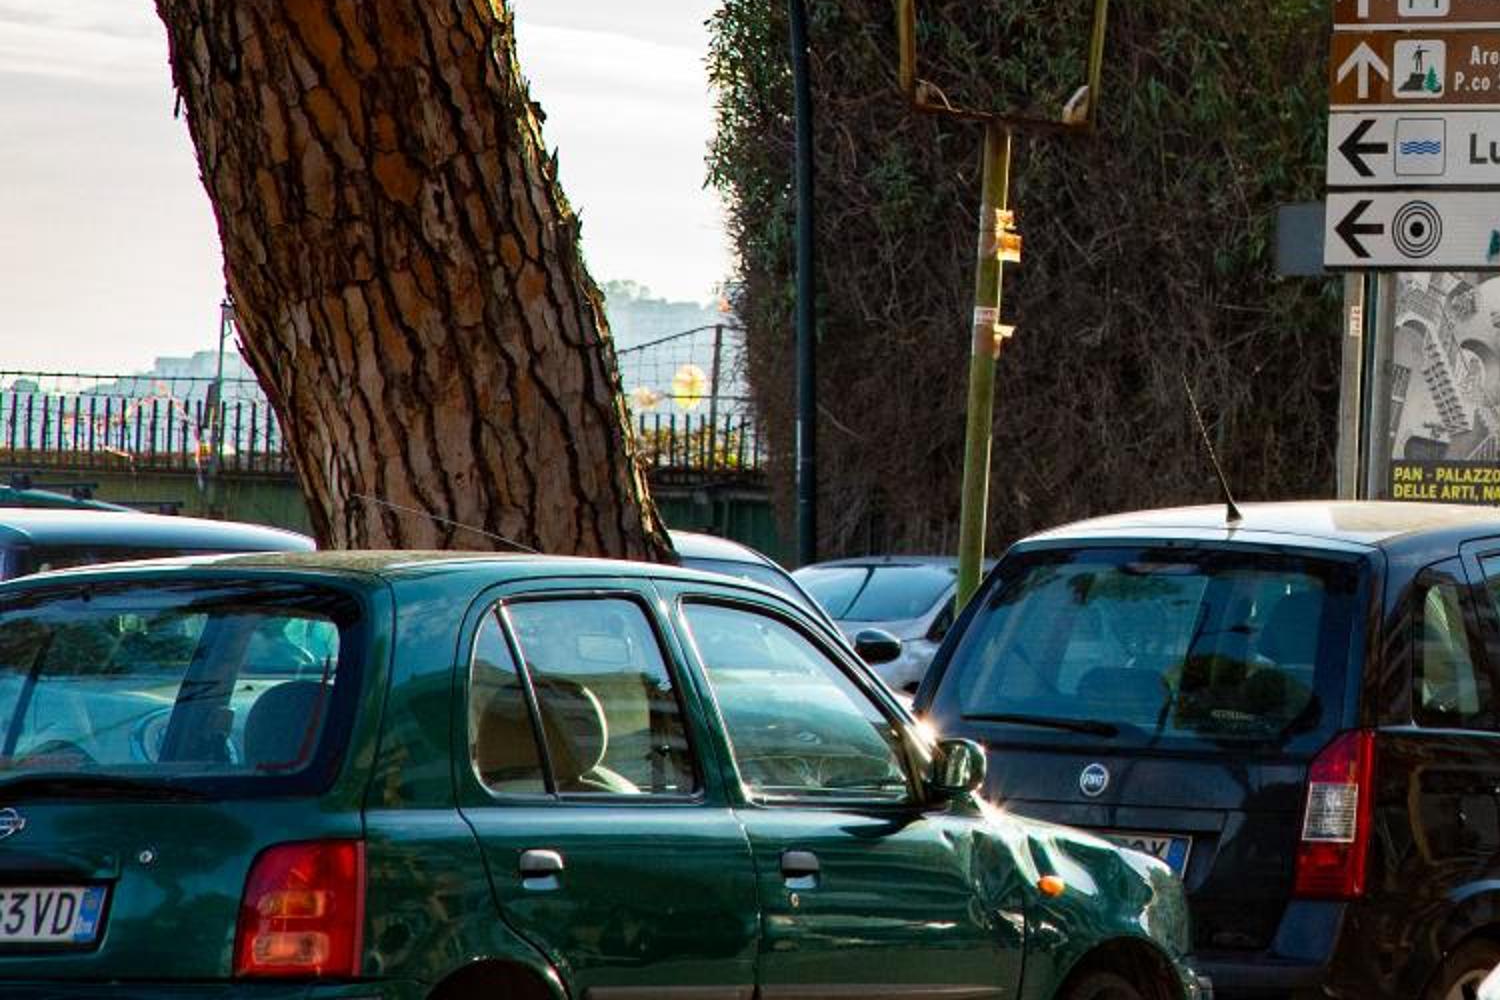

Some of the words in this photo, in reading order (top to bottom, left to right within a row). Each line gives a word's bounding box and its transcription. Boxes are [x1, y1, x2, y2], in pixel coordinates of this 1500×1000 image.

[1453, 73, 1490, 93] P.co
[1394, 467, 1423, 481] PAN
[1394, 483, 1437, 499] DELLE
[1441, 485, 1479, 502] ARTI,
